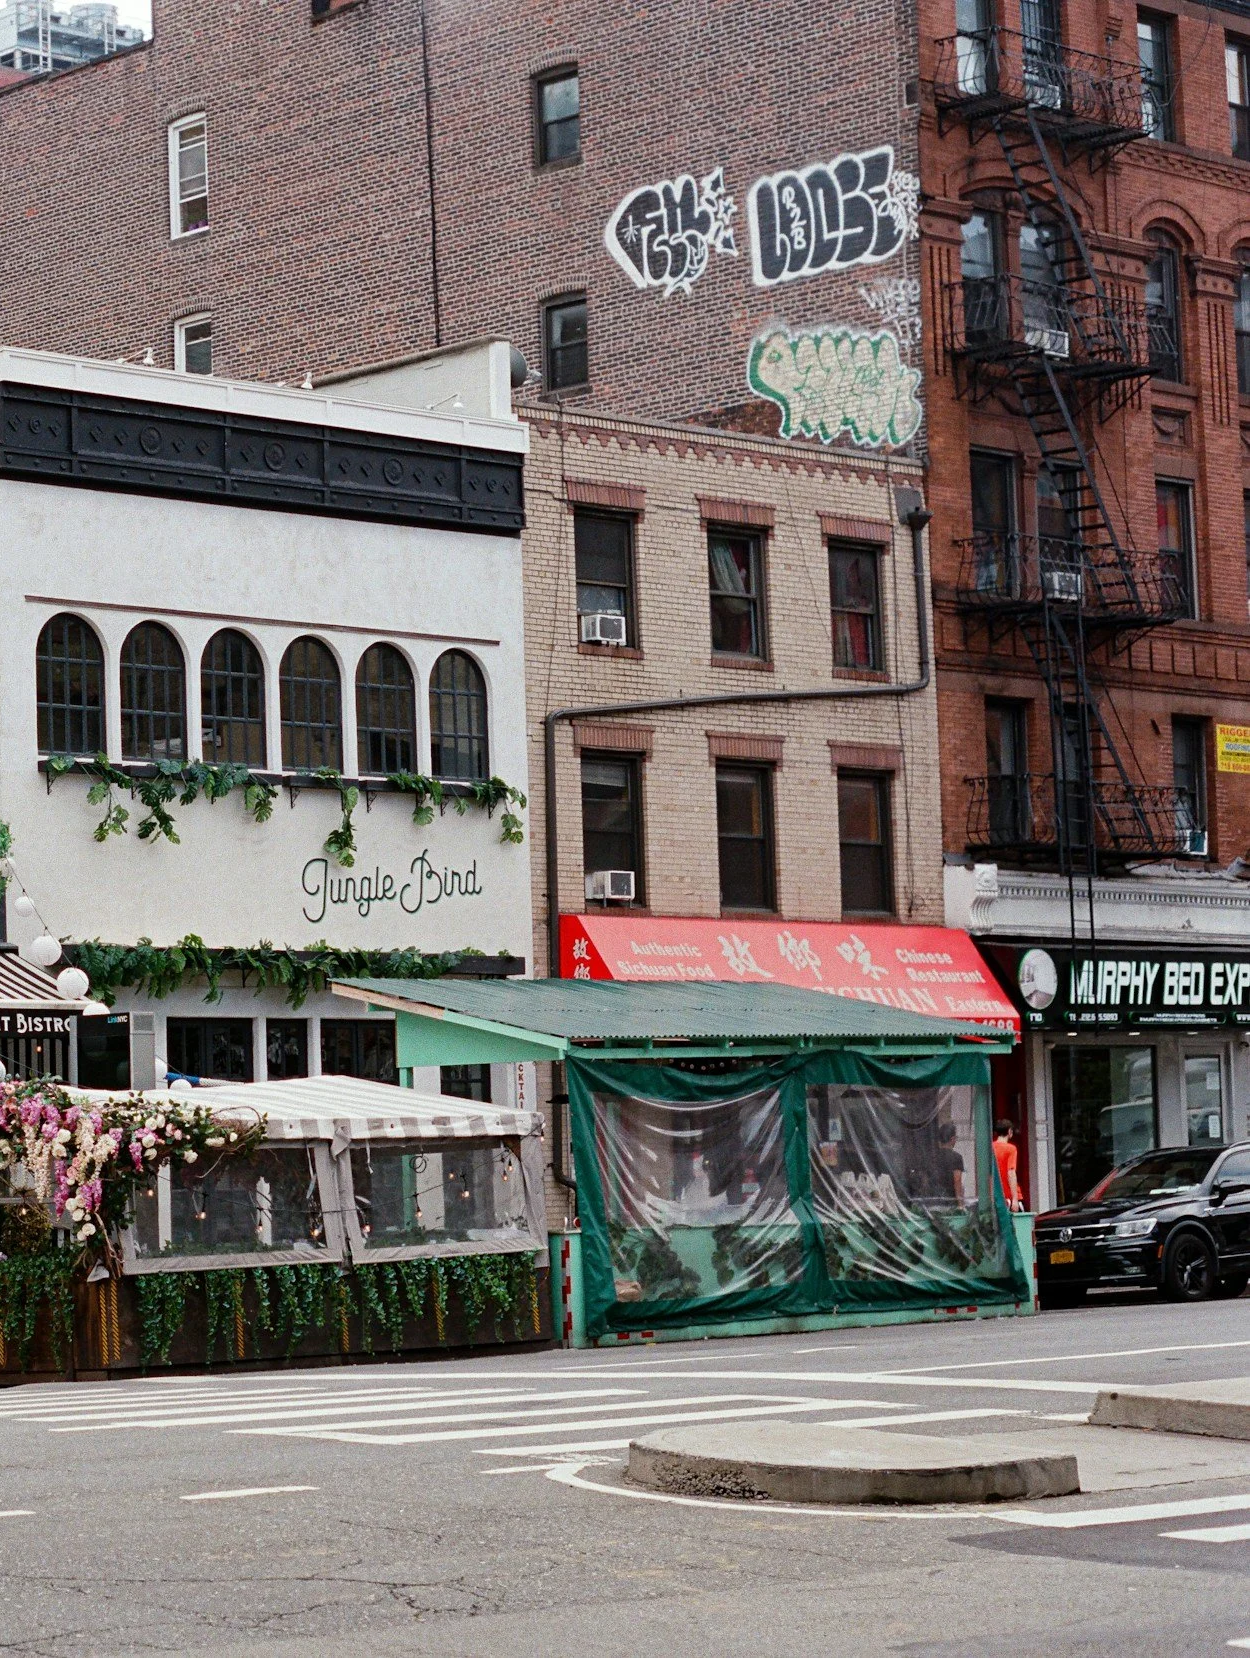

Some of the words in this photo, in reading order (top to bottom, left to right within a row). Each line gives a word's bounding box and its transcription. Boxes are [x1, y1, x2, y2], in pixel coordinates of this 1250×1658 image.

[302, 858, 397, 924] Jungle
[400, 848, 482, 914] Bird
[630, 940, 702, 958] Authentic
[895, 948, 954, 965] Chinese
[616, 960, 676, 977] Sichuan
[676, 962, 716, 979] Food
[905, 967, 987, 984] Restaurant
[1069, 960, 1161, 1005] MURPHY
[1162, 962, 1205, 1006] BED
[1209, 962, 1250, 1006] EXP
[107, 1015, 128, 1024] LinkNYC
